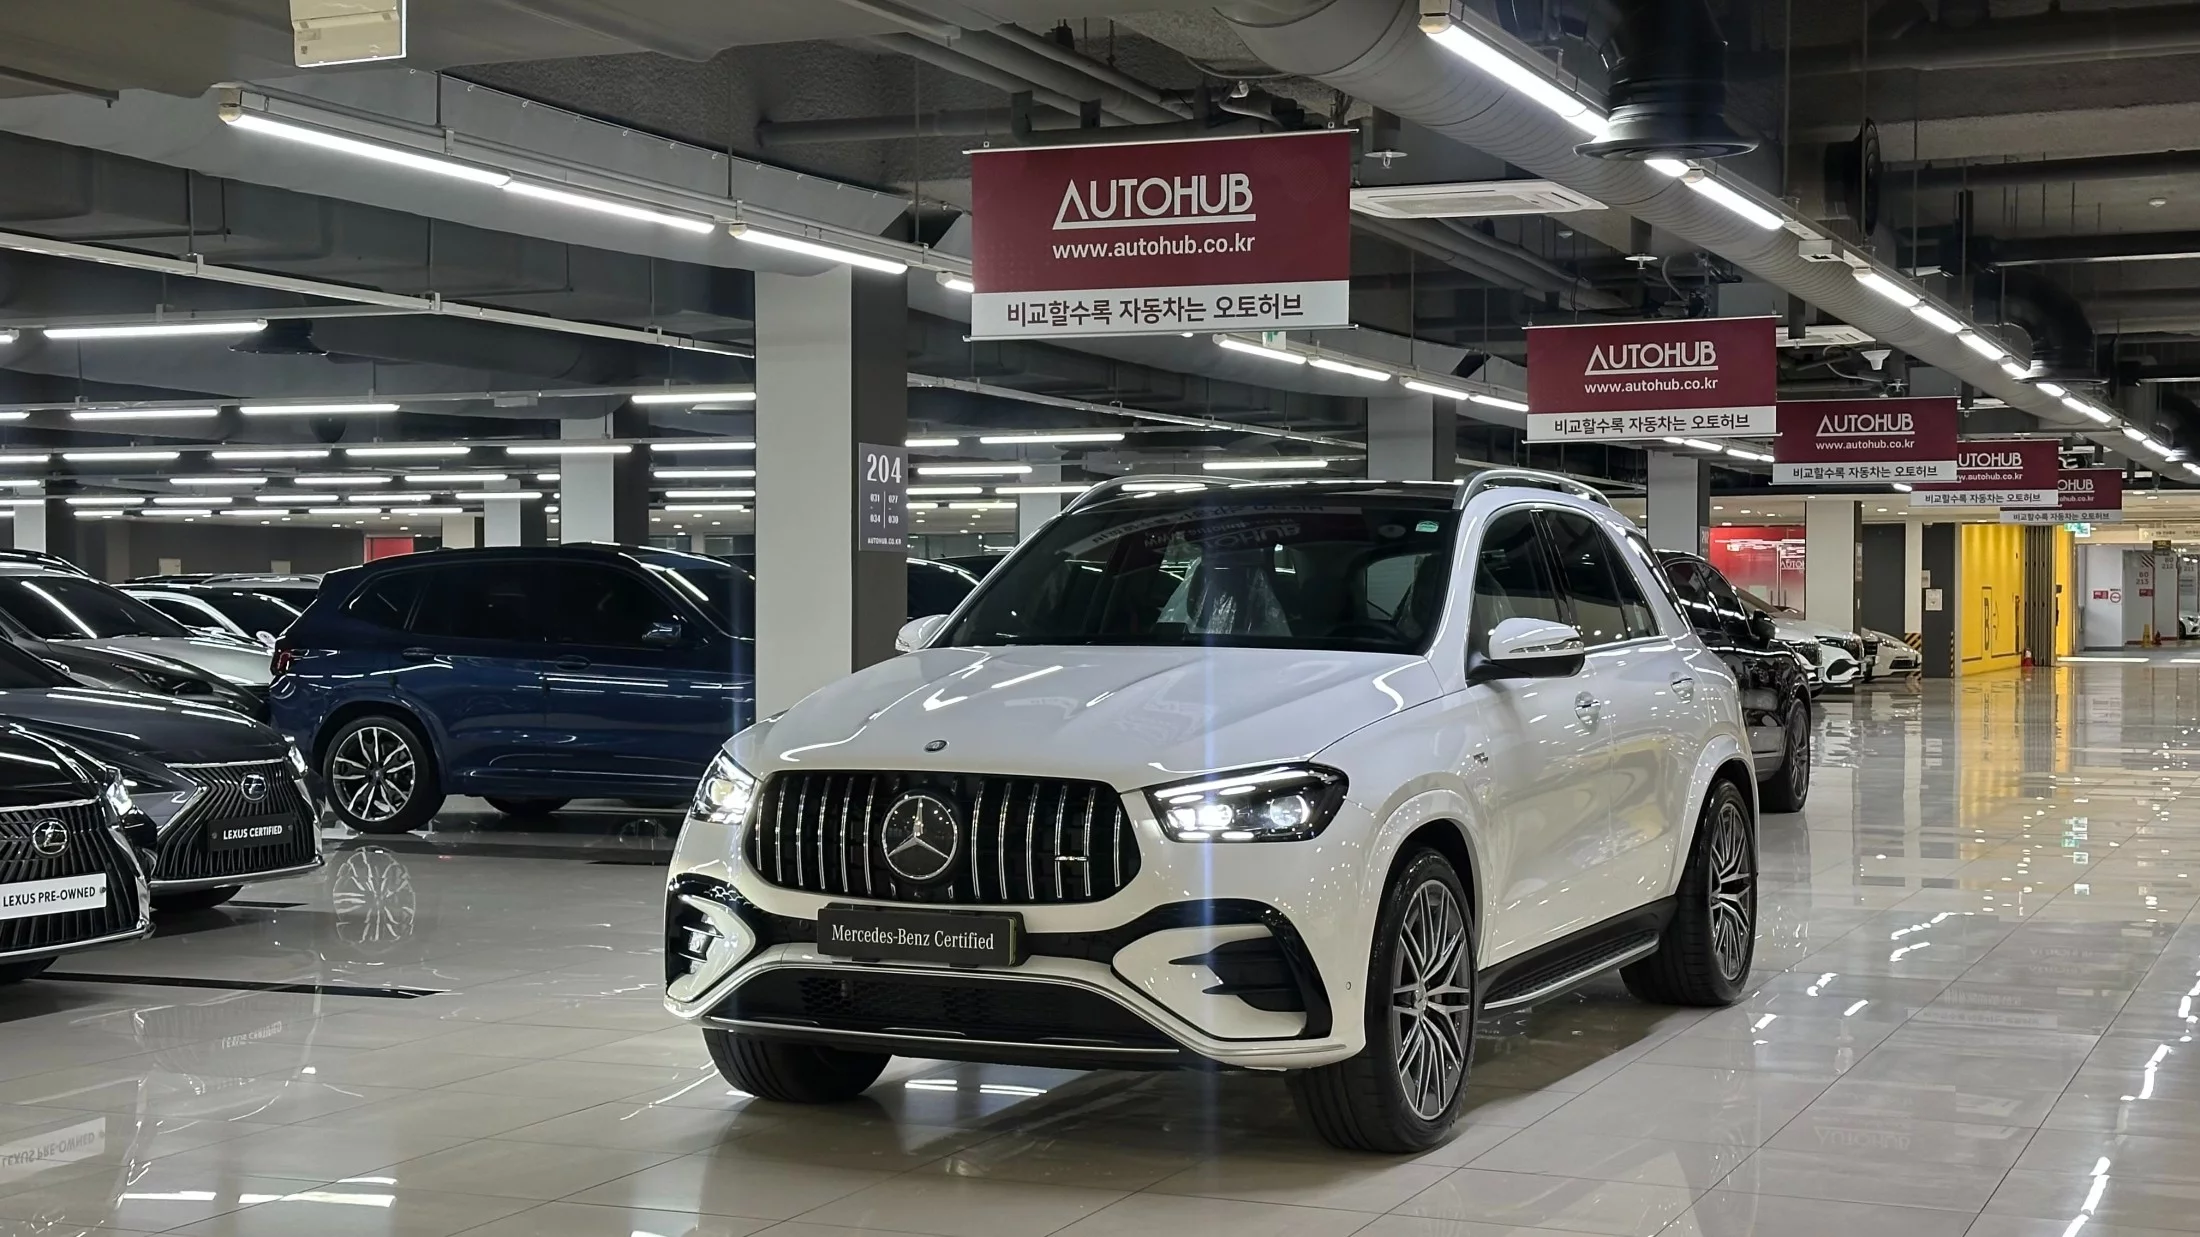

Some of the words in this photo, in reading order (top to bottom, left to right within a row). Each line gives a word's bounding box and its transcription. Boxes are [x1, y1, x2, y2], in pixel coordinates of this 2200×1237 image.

[1052, 172, 1256, 230] AUTOHUB
[1052, 232, 1256, 260] www.autohub.co.kr
[1007, 299, 1113, 328] 비교할수록
[1119, 296, 1207, 325] 자동차는
[1213, 293, 1304, 321] 오토허브
[1584, 340, 1719, 376] AUTOHUB
[1584, 377, 1719, 394] www.autohub.co.kr
[1554, 417, 1625, 435] 비교할수록
[1629, 416, 1687, 433] 자동차는
[1691, 413, 1750, 431] 오토허브
[1816, 413, 1915, 437] AUTOHUB
[1815, 438, 1915, 450] www.autohub.co.kr
[866, 453, 902, 485] 204
[1957, 452, 2023, 470] UTOHUB
[1793, 467, 1846, 480] 비교할수록
[1848, 466, 1891, 479] 자동차는
[1894, 465, 1938, 478] 오토허브
[1957, 472, 2023, 481] w.autohub.co.kr
[2057, 479, 2095, 493] OHUB
[1925, 494, 1967, 504] 비교할수록
[1969, 493, 2004, 503] 자동차는
[2006, 492, 2041, 502] 오토허브
[223, 827, 248, 840] LEXUS
[249, 824, 283, 838] CERTIFIED
[3, 892, 36, 907] LEXUS
[38, 886, 96, 903] PRE-OWNED
[831, 924, 930, 947] Mercedes-Benz
[934, 930, 994, 950] Certified
